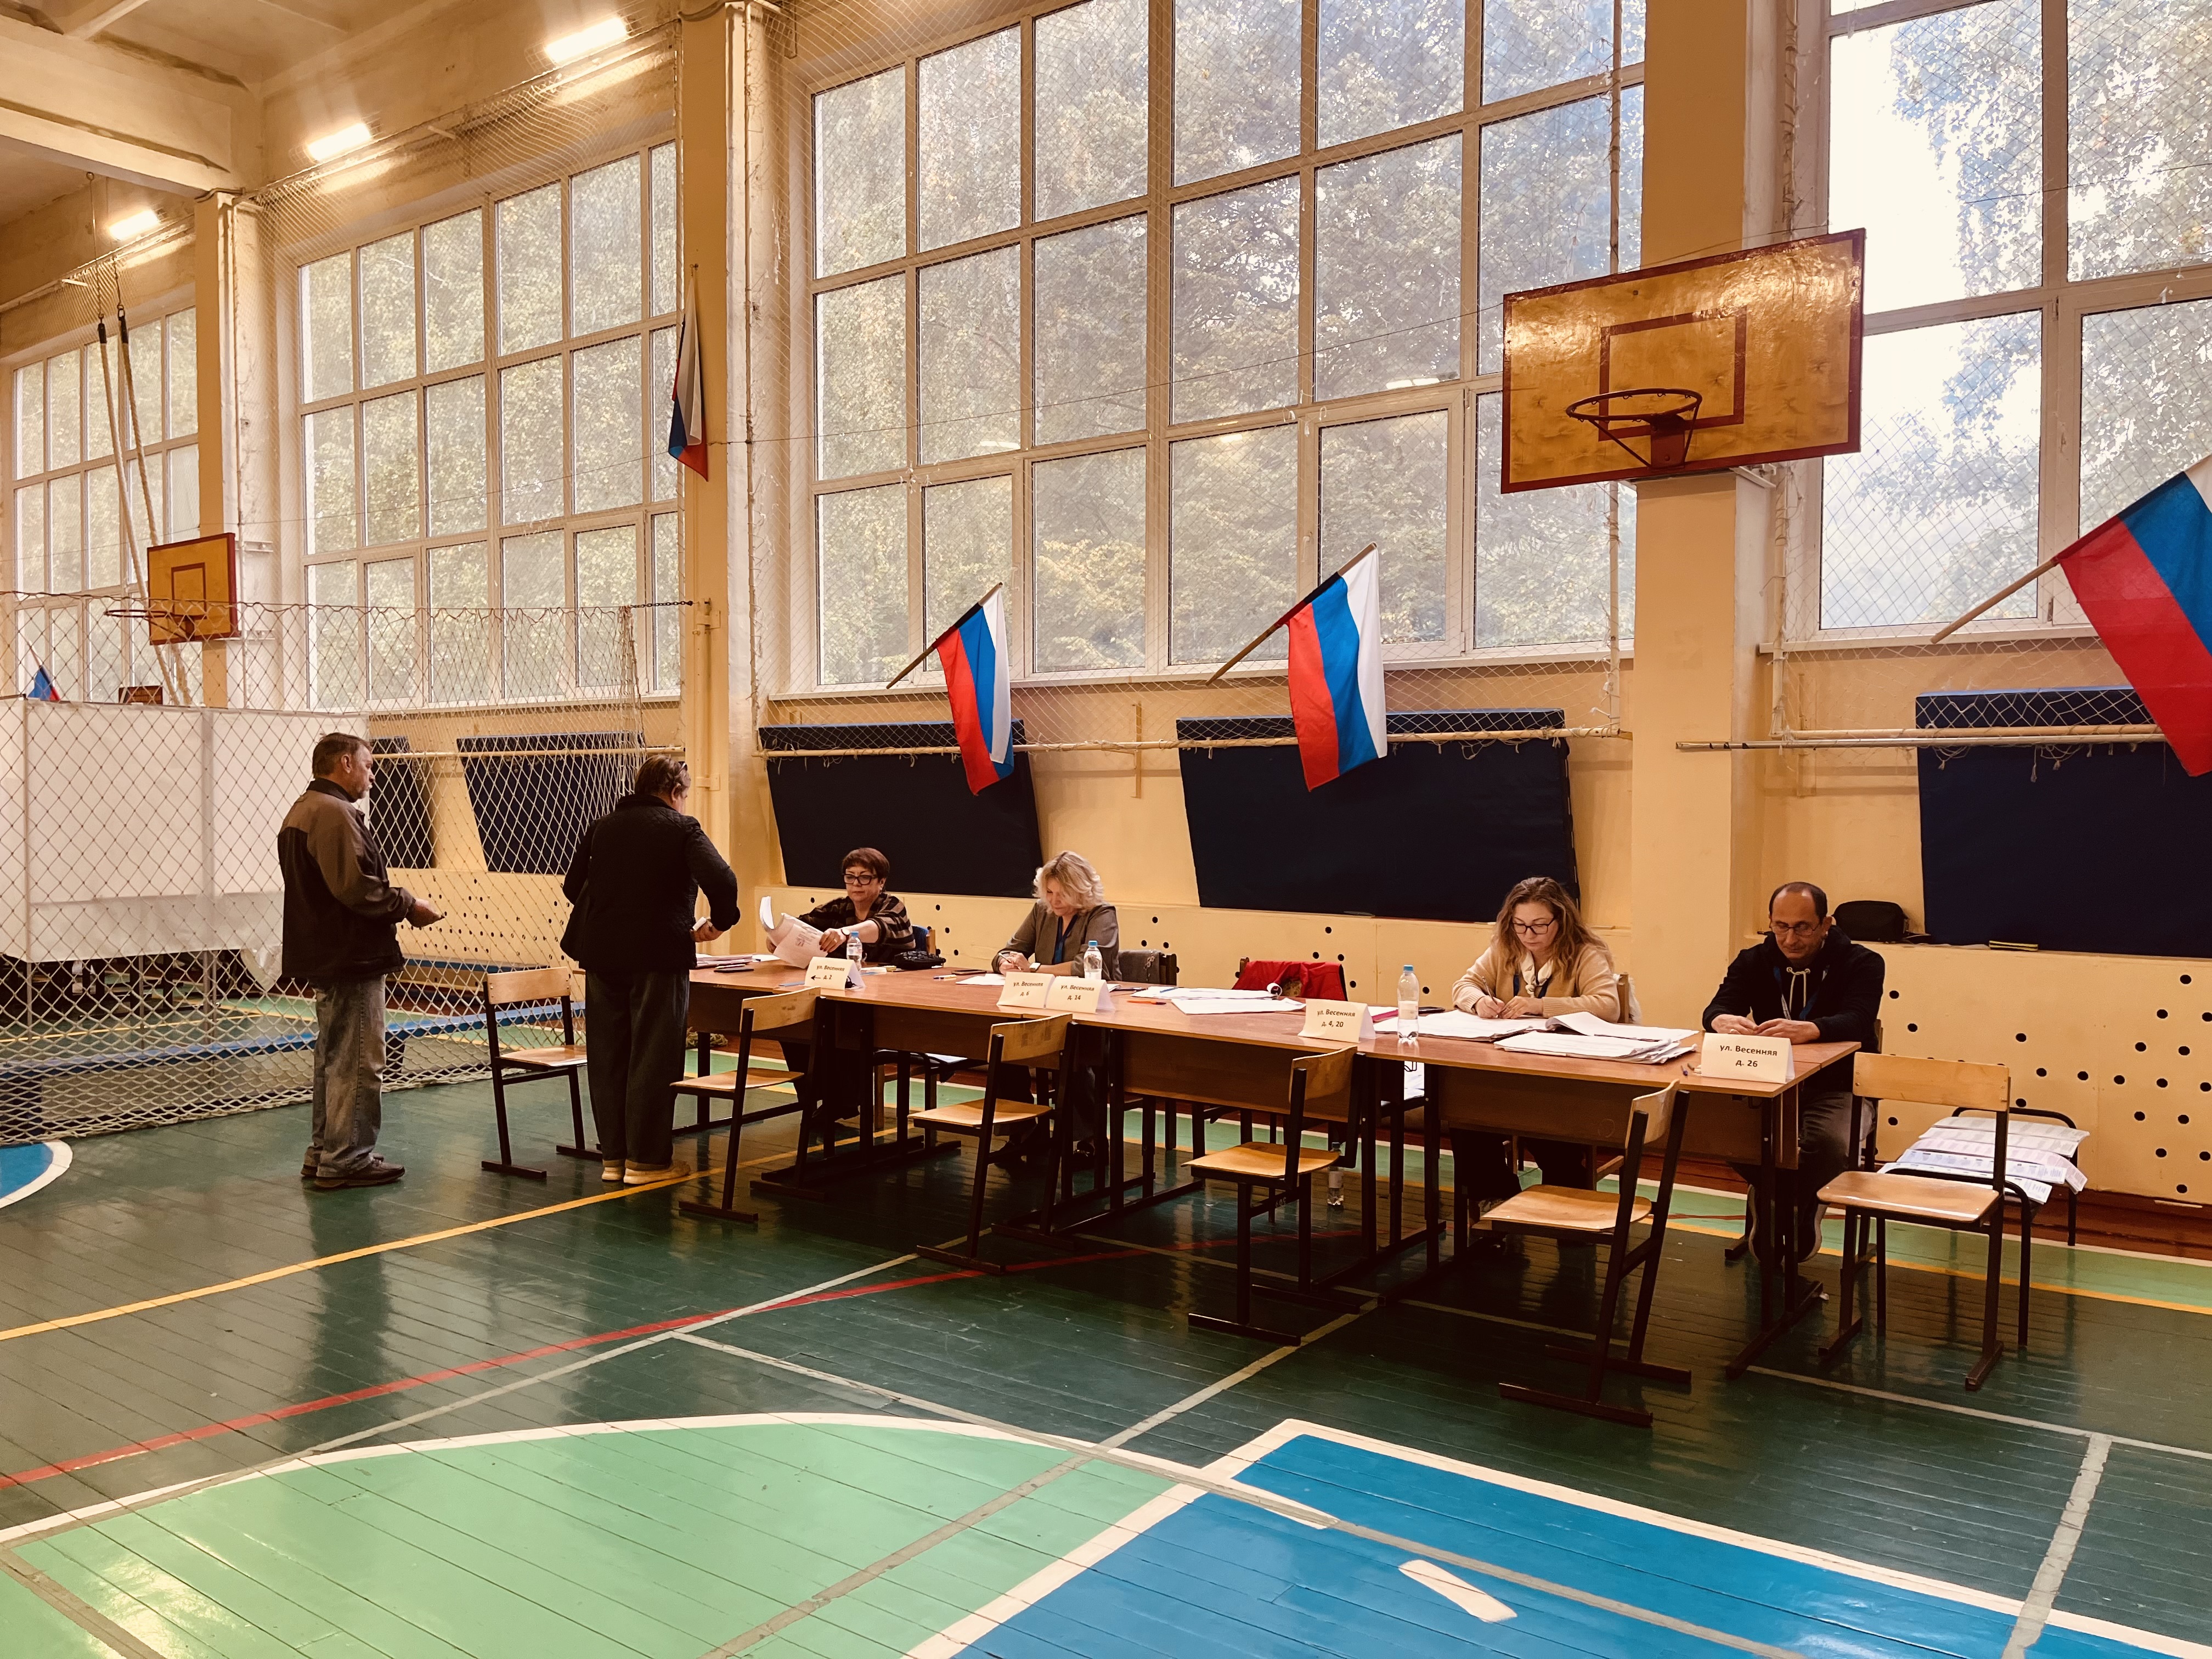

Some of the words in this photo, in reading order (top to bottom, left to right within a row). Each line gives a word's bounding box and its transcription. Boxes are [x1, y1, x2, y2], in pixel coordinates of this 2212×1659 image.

[1325, 1009, 1356, 1017] Весенняя
[1735, 1045, 1778, 1057] Весенняя
[1747, 1059, 1758, 1068] 26
